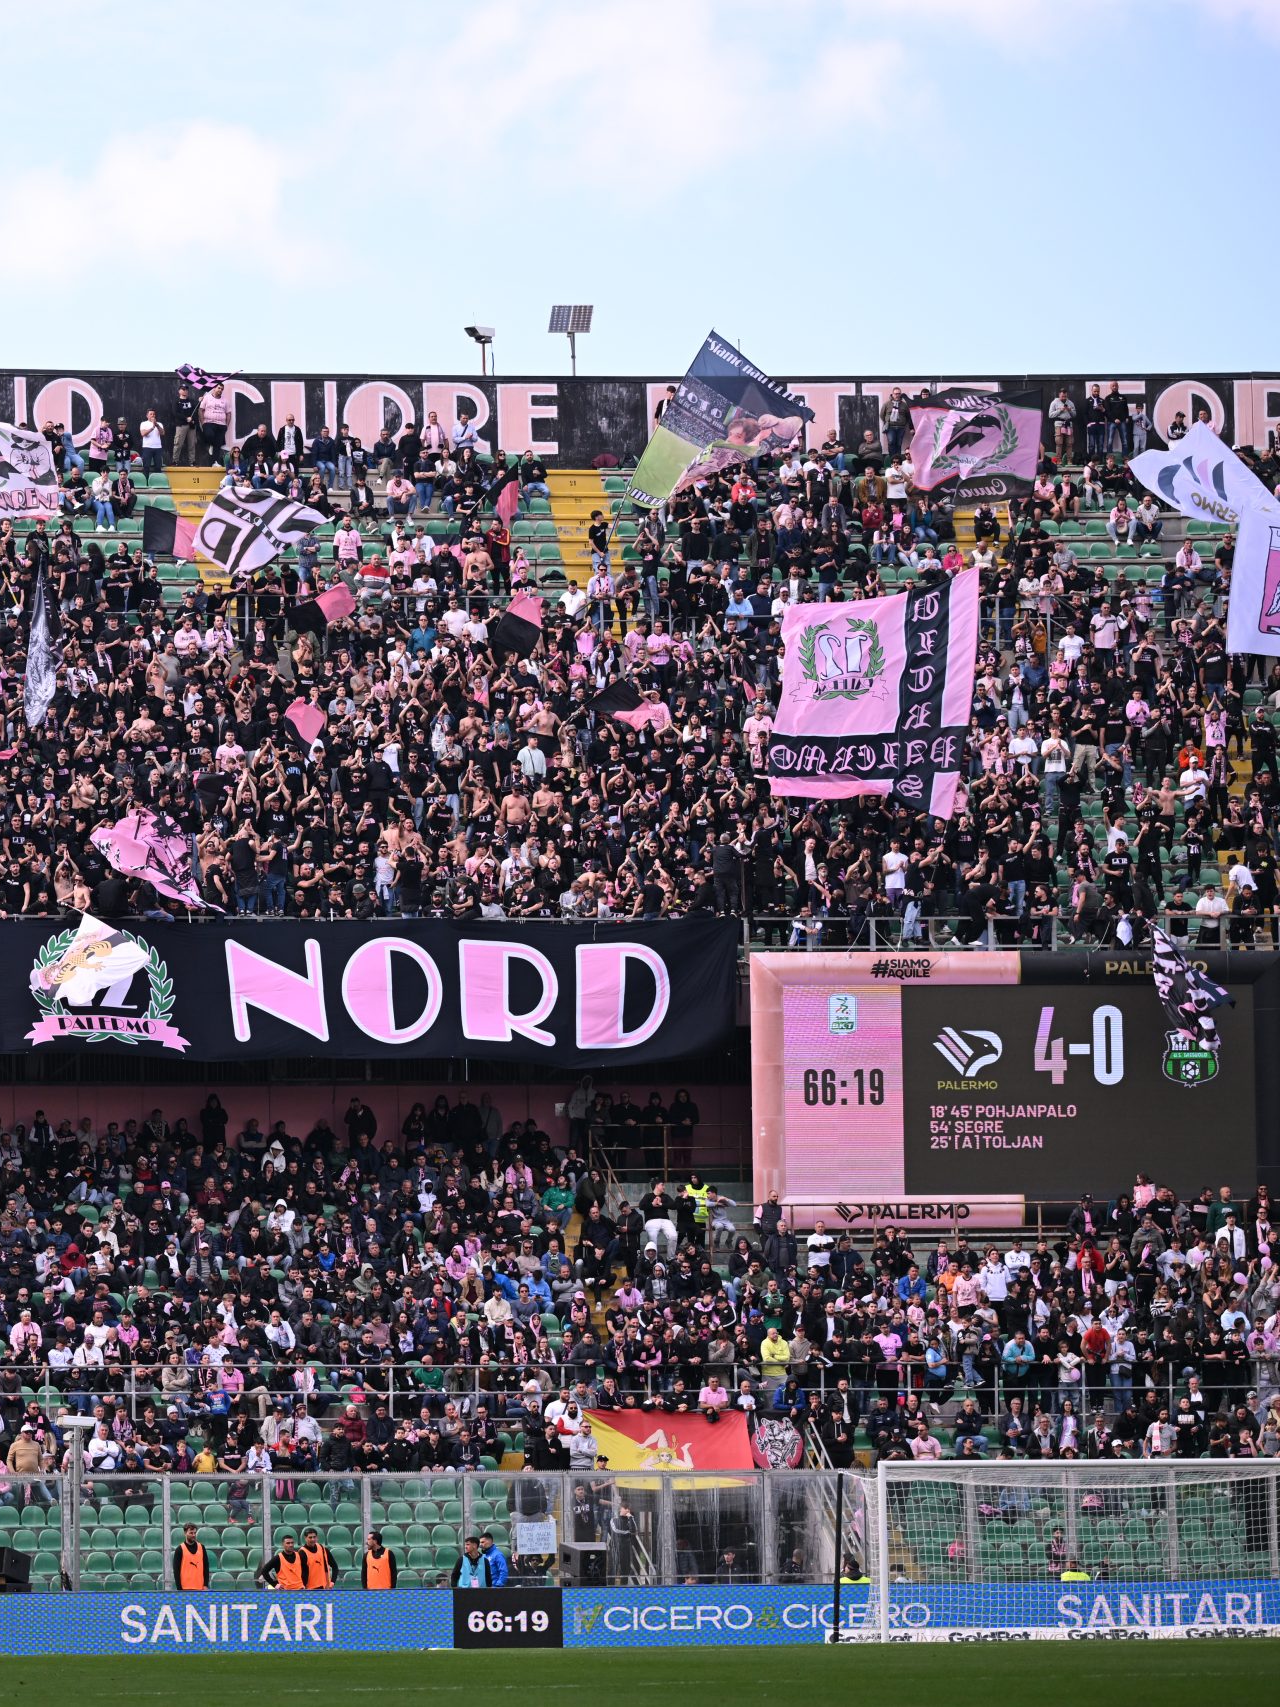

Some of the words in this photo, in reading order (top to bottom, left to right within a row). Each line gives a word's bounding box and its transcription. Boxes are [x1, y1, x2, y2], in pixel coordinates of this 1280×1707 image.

[216, 379, 560, 455] CUORE
[1189, 491, 1239, 523] ERMO
[887, 969, 931, 980] AQUILE
[1105, 961, 1208, 975] PALEO
[224, 936, 671, 1050] NORD
[57, 1017, 157, 1036] PALERMO
[1034, 1004, 1125, 1086] 4-0
[803, 1069, 884, 1106] 66:19
[937, 1080, 998, 1090] PALERMO
[930, 1105, 948, 1118] 18'
[951, 1105, 973, 1118] 45'
[975, 1104, 1077, 1118] POHJANPALO
[930, 1120, 952, 1133] 54'
[955, 1120, 1004, 1133] SEGRE
[930, 1136, 952, 1149] 25'
[983, 1135, 1043, 1149] TOLJAN
[867, 1203, 970, 1220] PALERMO
[1057, 1592, 1263, 1629] SANITARI
[120, 1603, 334, 1643] SANITARI
[467, 1610, 549, 1633] 66:19
